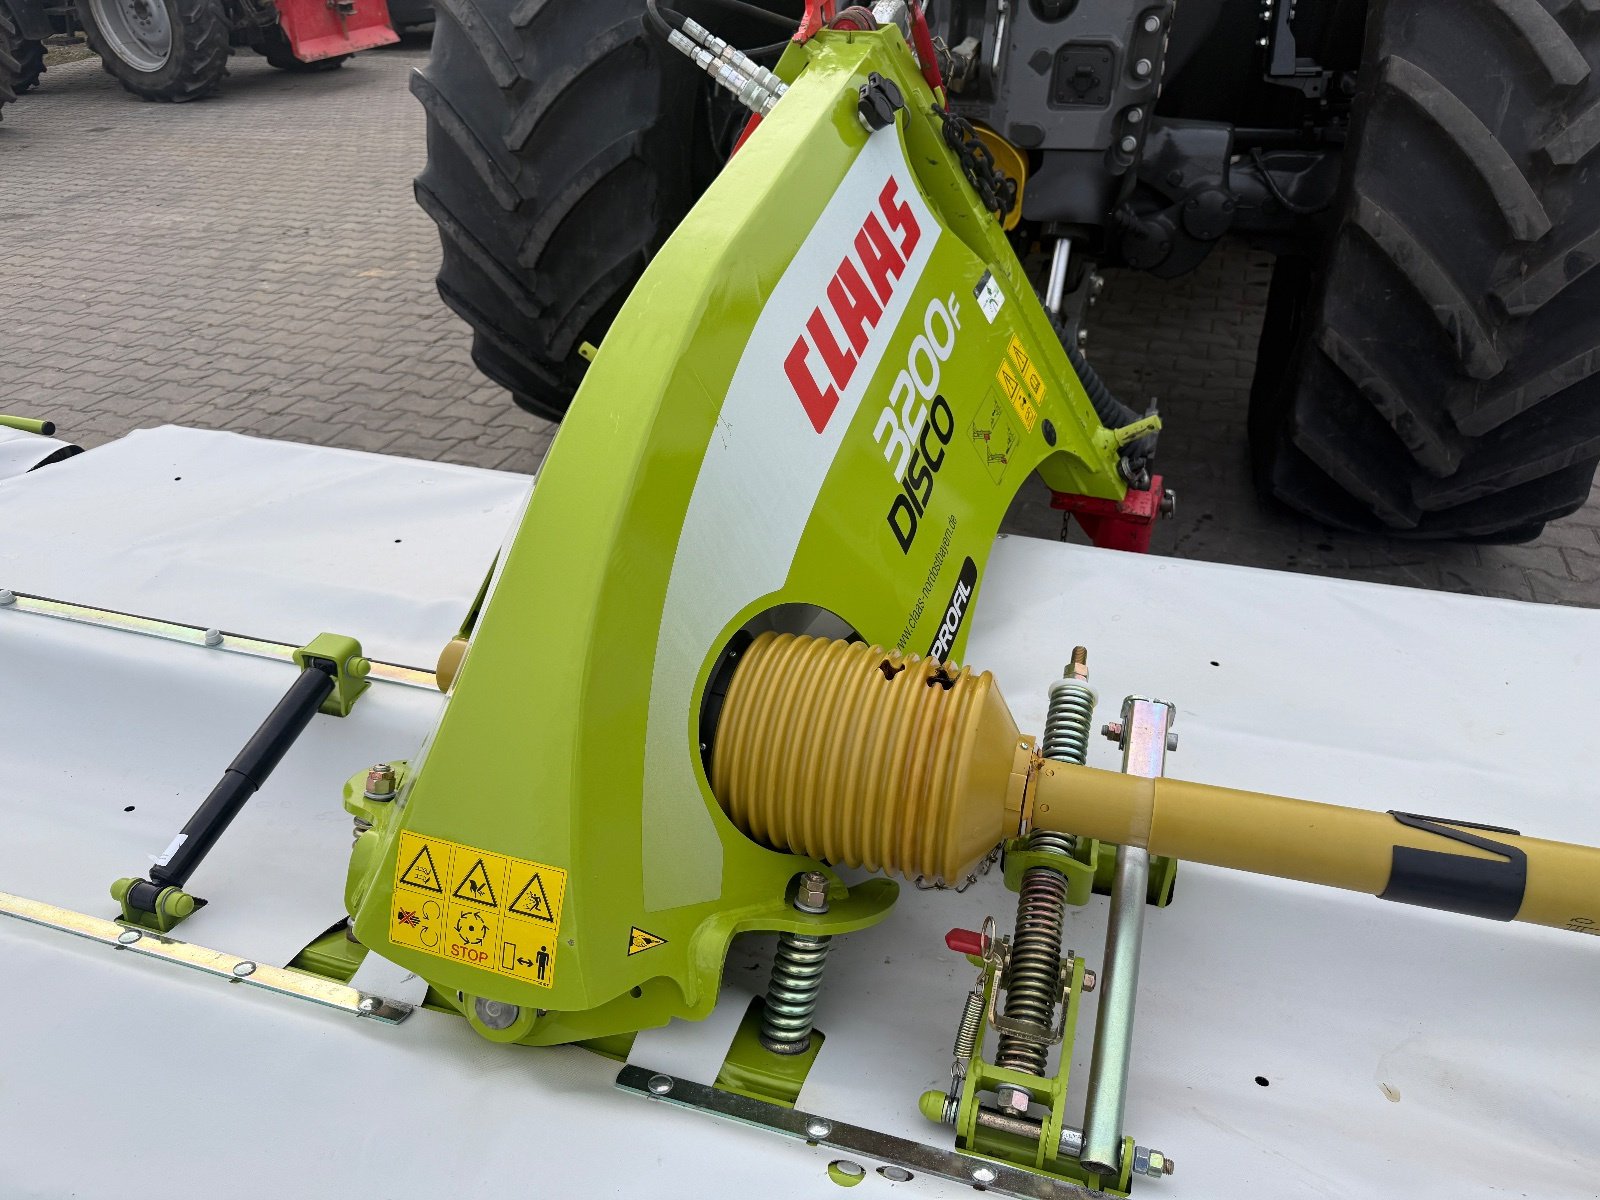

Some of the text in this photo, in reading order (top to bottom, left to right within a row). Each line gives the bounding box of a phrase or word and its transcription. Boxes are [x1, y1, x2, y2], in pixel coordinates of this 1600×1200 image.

[783, 174, 922, 435] CLAAS
[886, 394, 955, 556] DISCO
[930, 579, 972, 661] PROFIL
[451, 943, 489, 963] STOP
